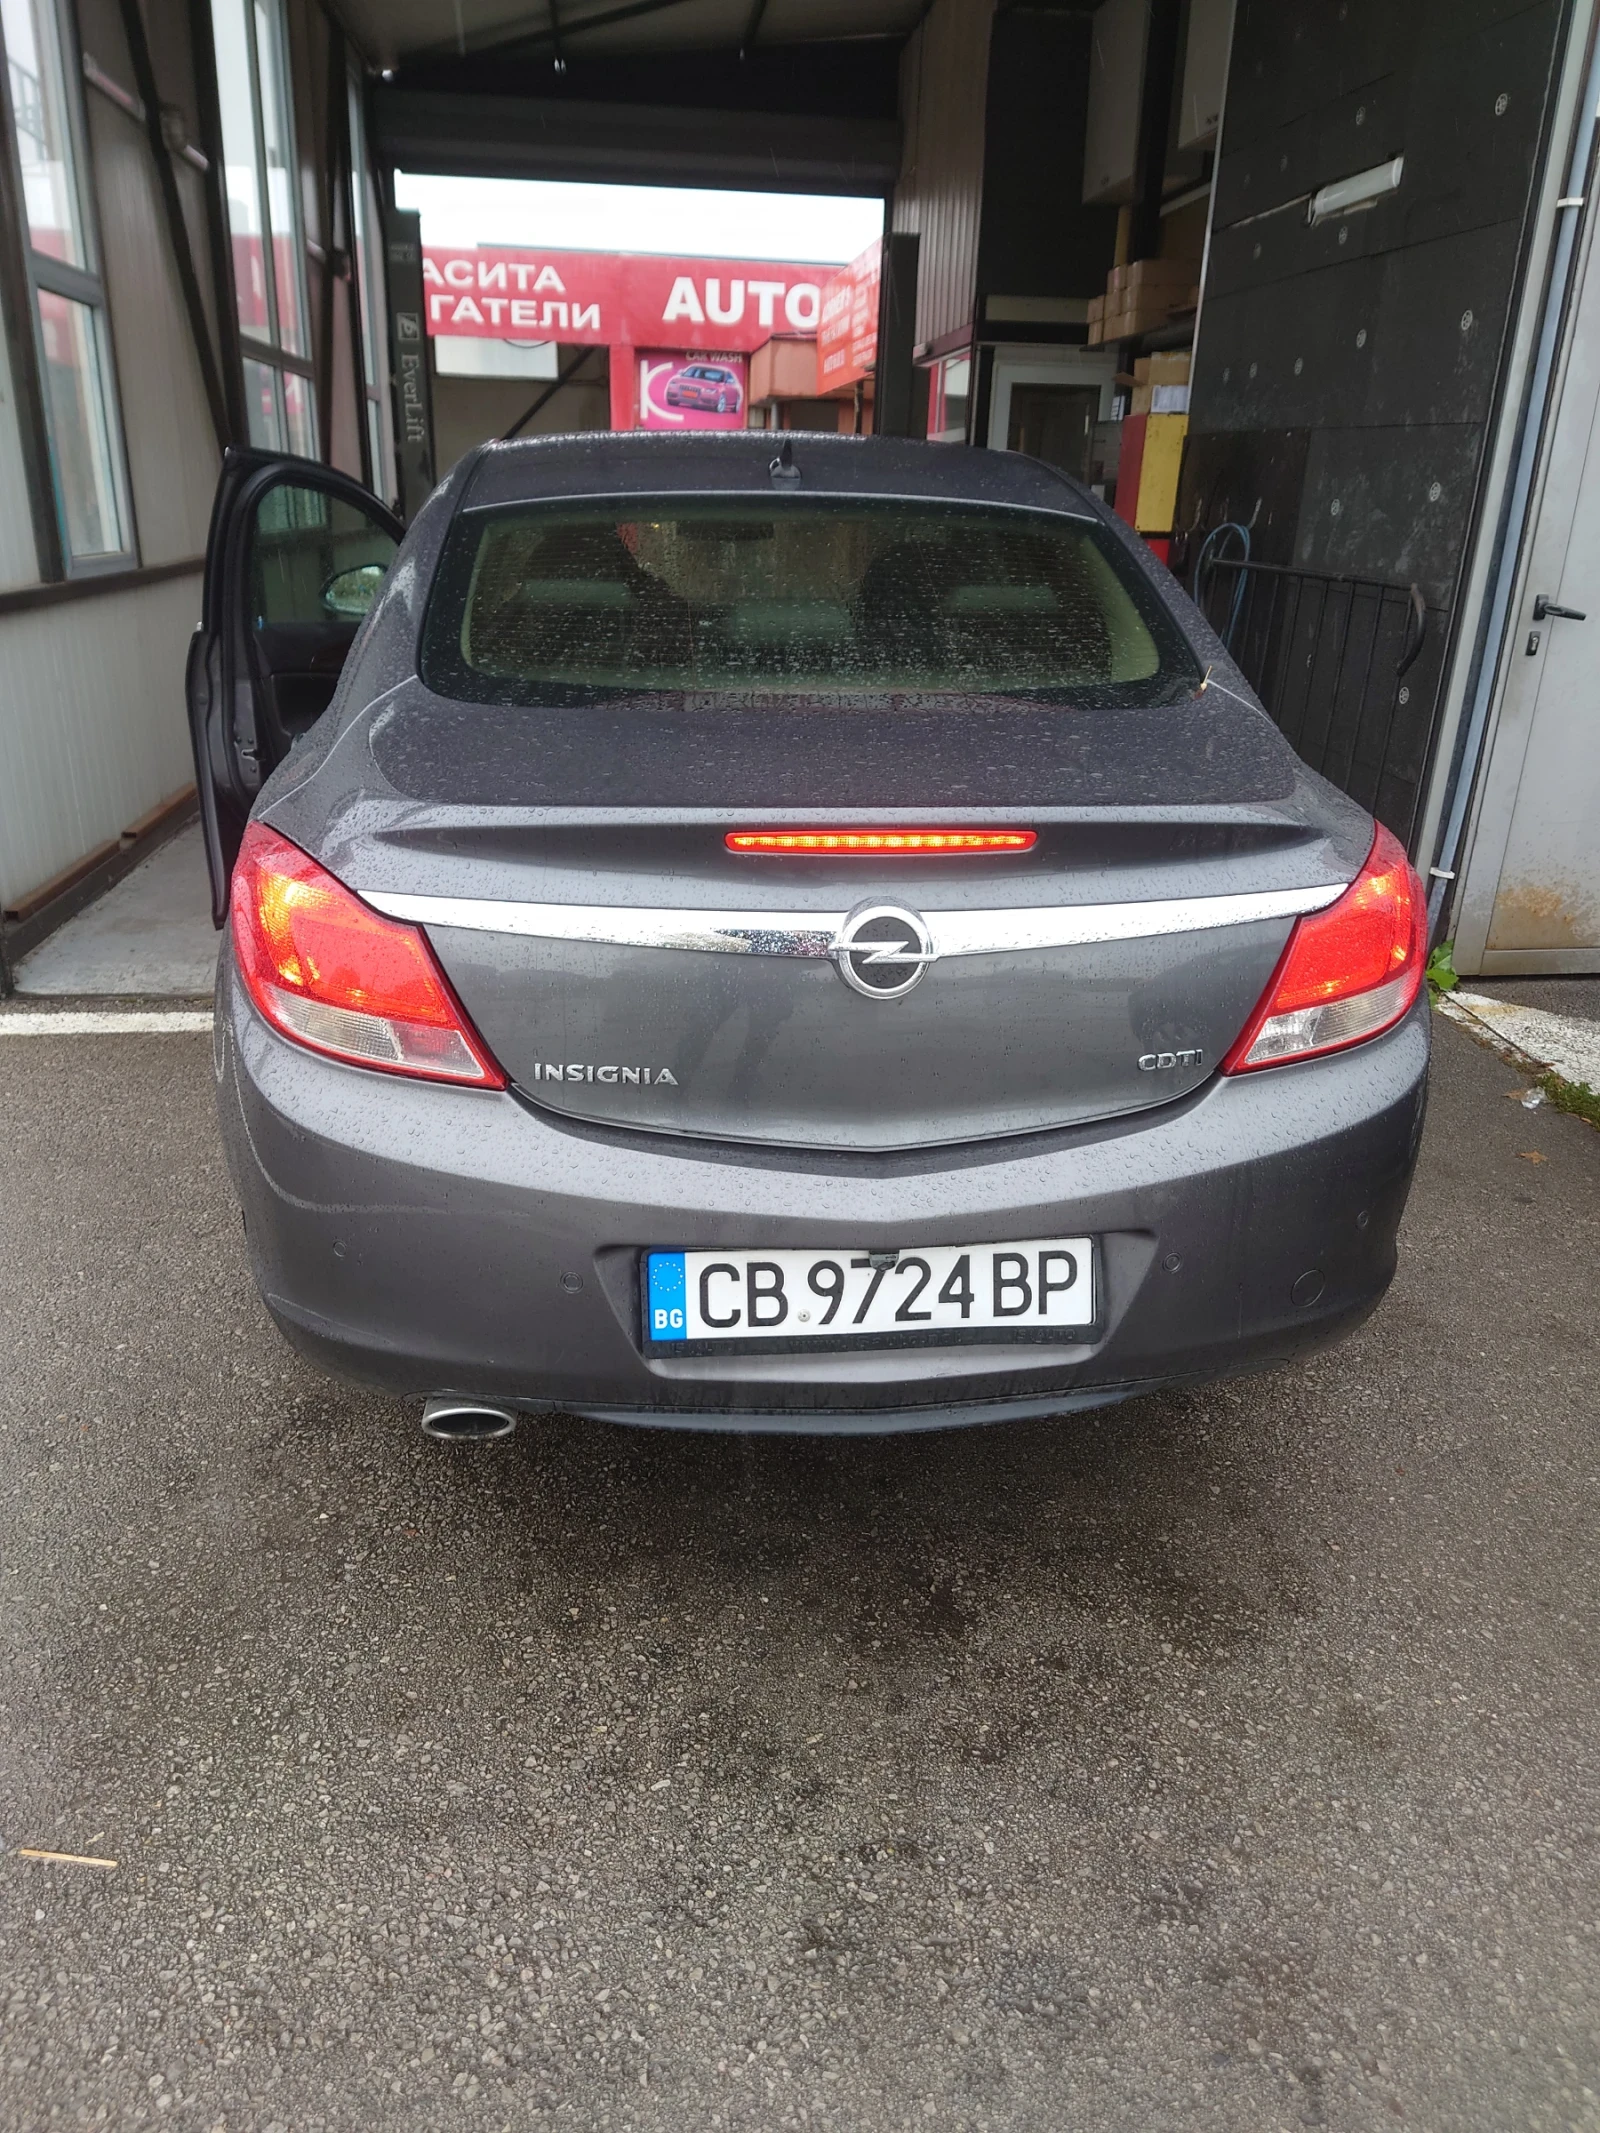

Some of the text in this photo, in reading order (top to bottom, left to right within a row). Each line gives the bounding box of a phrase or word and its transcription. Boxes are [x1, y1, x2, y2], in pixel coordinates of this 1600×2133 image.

[422, 257, 567, 294] АСИТА
[430, 294, 601, 331] ГАТЕЛИ
[661, 276, 821, 328] AUTO
[709, 352, 744, 364] WASH
[401, 354, 425, 442] EverLift
[534, 1062, 680, 1086] INSIGNIA
[1137, 1048, 1204, 1072] CDTI
[699, 1250, 1078, 1329] CB 9724 BP
[653, 1308, 683, 1330] BG
